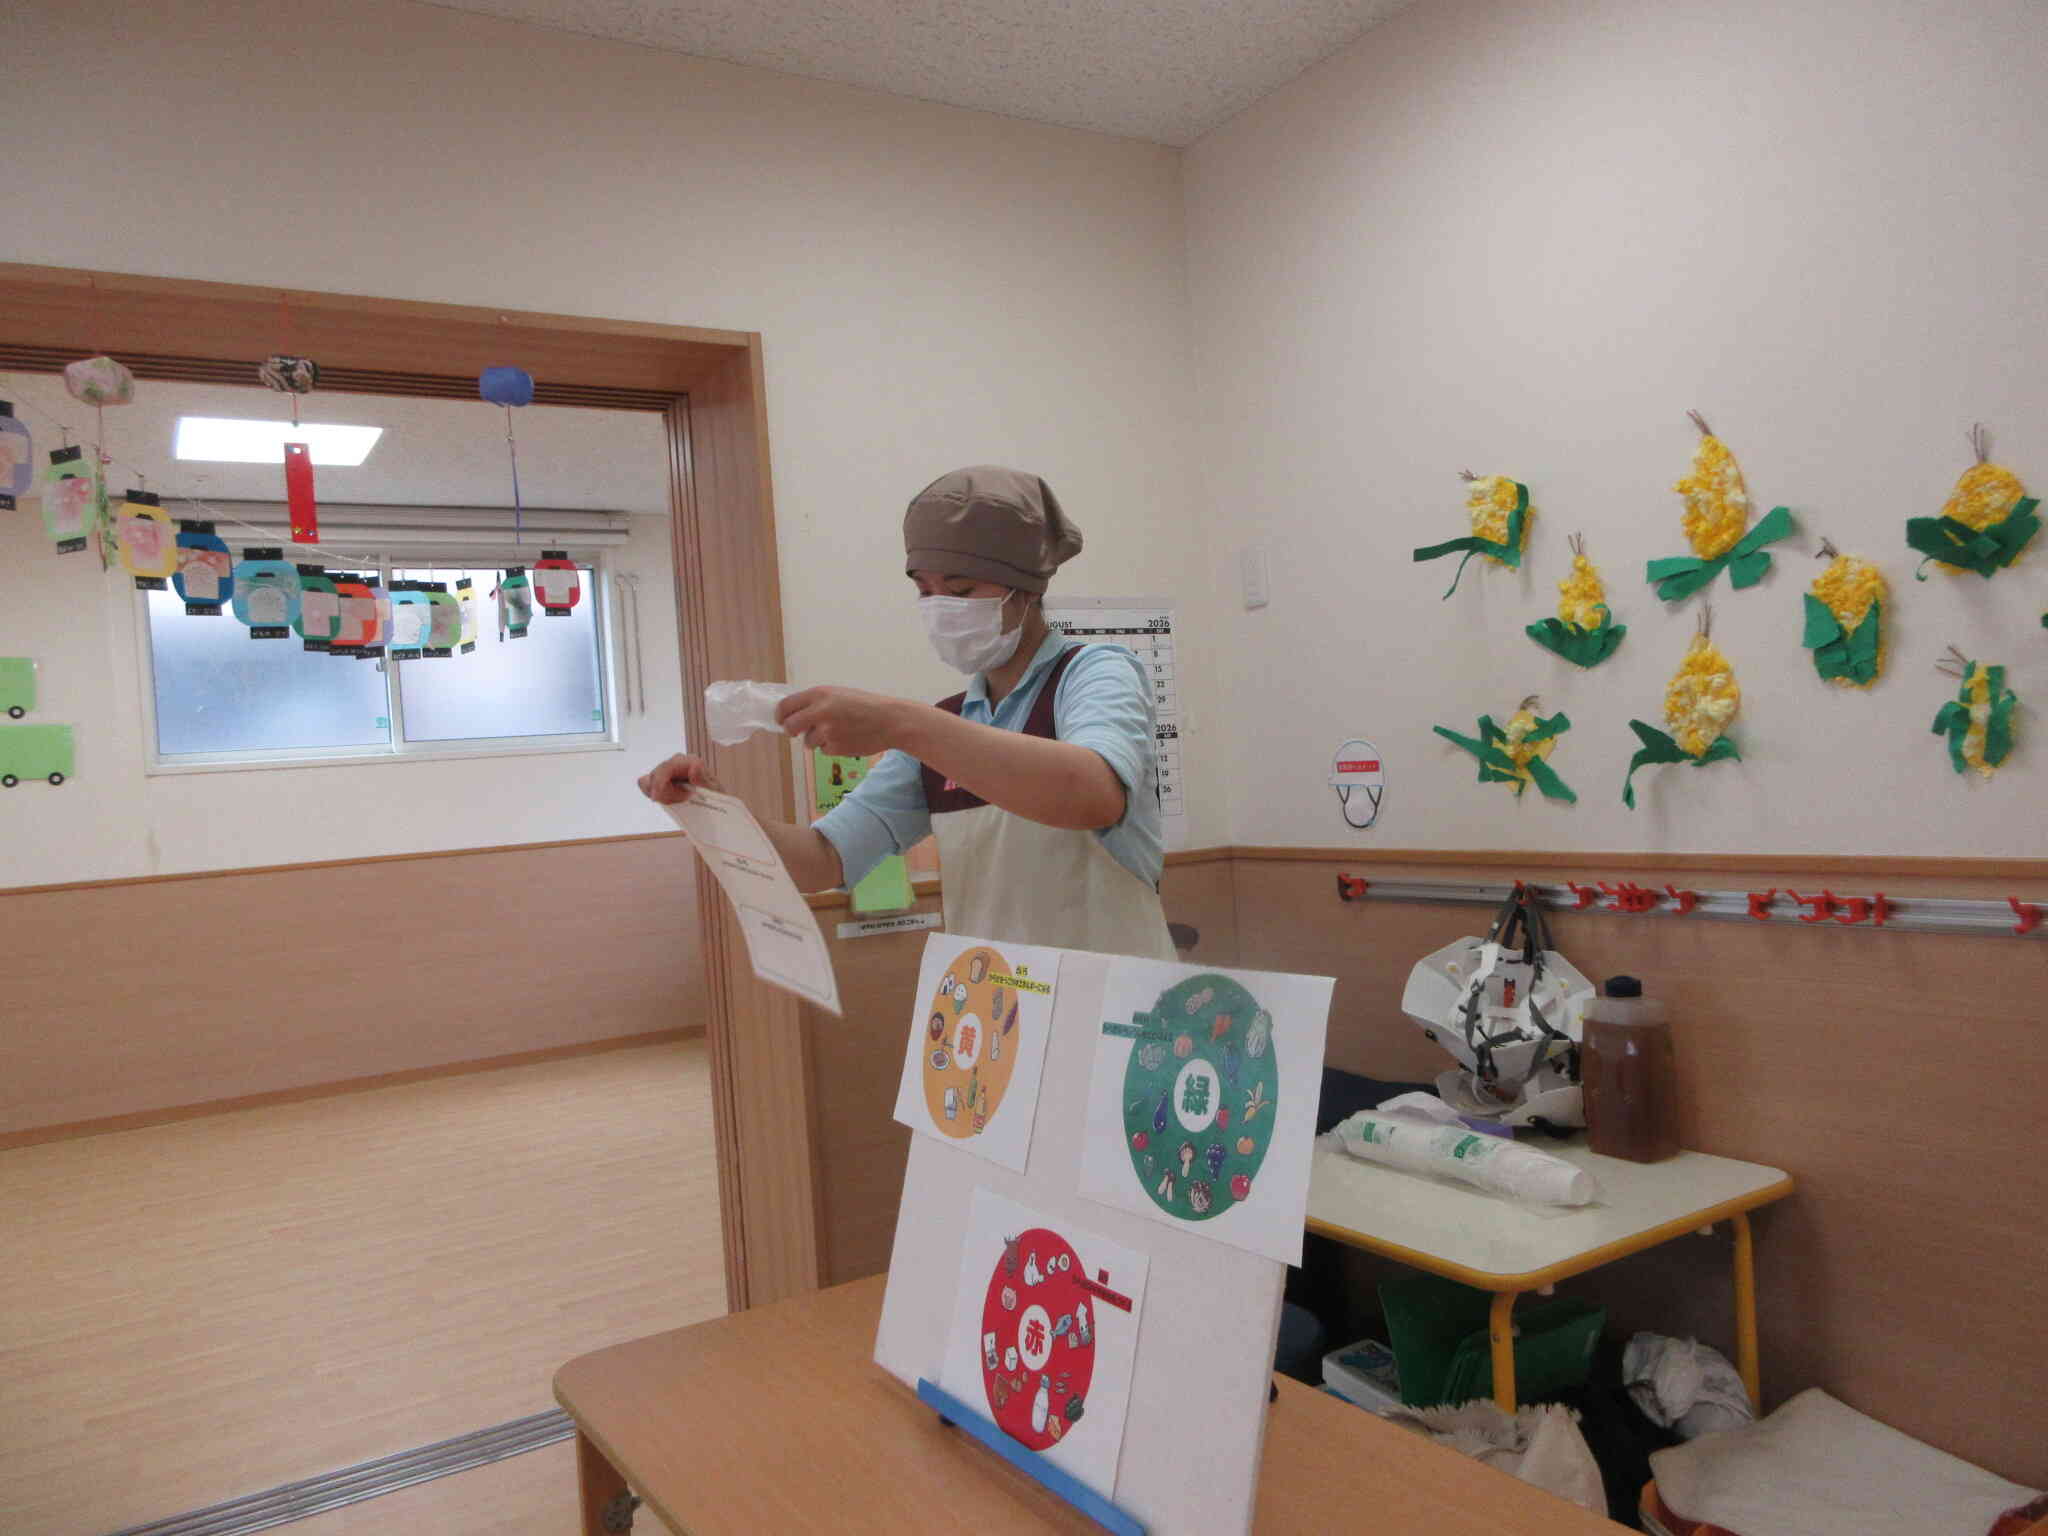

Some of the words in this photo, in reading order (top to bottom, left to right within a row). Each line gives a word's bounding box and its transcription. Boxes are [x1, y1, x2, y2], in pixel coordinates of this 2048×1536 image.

[1148, 619, 1170, 628] 2026
[1154, 665, 1162, 673] 15
[1157, 696, 1166, 704] 29
[1156, 724, 1176, 732] 2026
[959, 1025, 977, 1057] 黄
[1183, 1073, 1210, 1115] 緑
[1025, 1319, 1045, 1357] 赤
